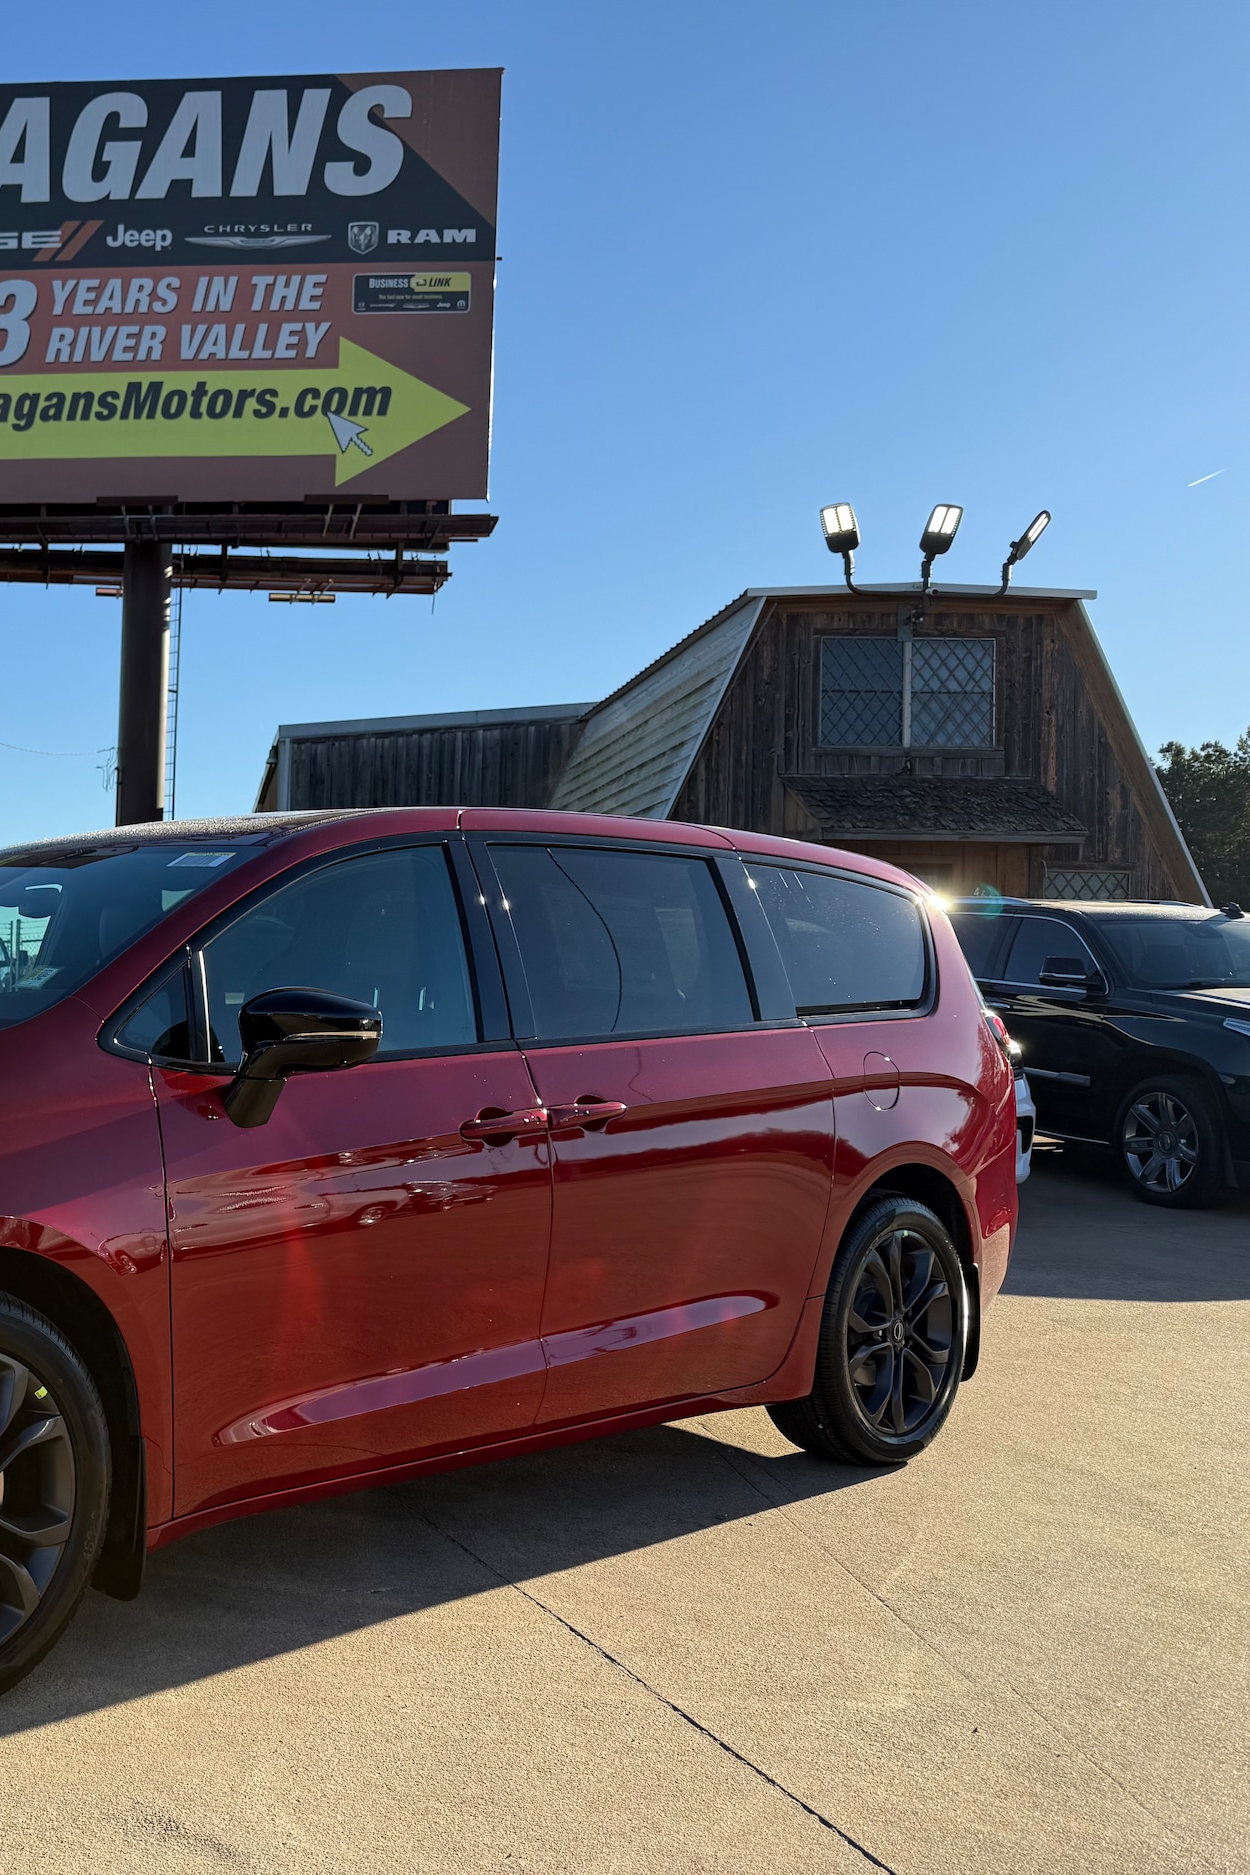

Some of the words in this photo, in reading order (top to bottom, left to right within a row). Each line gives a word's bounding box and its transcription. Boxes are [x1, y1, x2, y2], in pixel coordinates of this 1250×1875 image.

[106, 224, 171, 251] Jeep
[204, 223, 313, 233] CHRYSLER
[387, 228, 477, 244] RAM
[369, 278, 409, 288] BUSINESS
[428, 277, 452, 287] LINK
[52, 276, 181, 316] YEARS
[191, 275, 239, 313] IN
[250, 274, 328, 312] THE
[45, 324, 167, 363] RIVER
[180, 321, 332, 361] VALLEY
